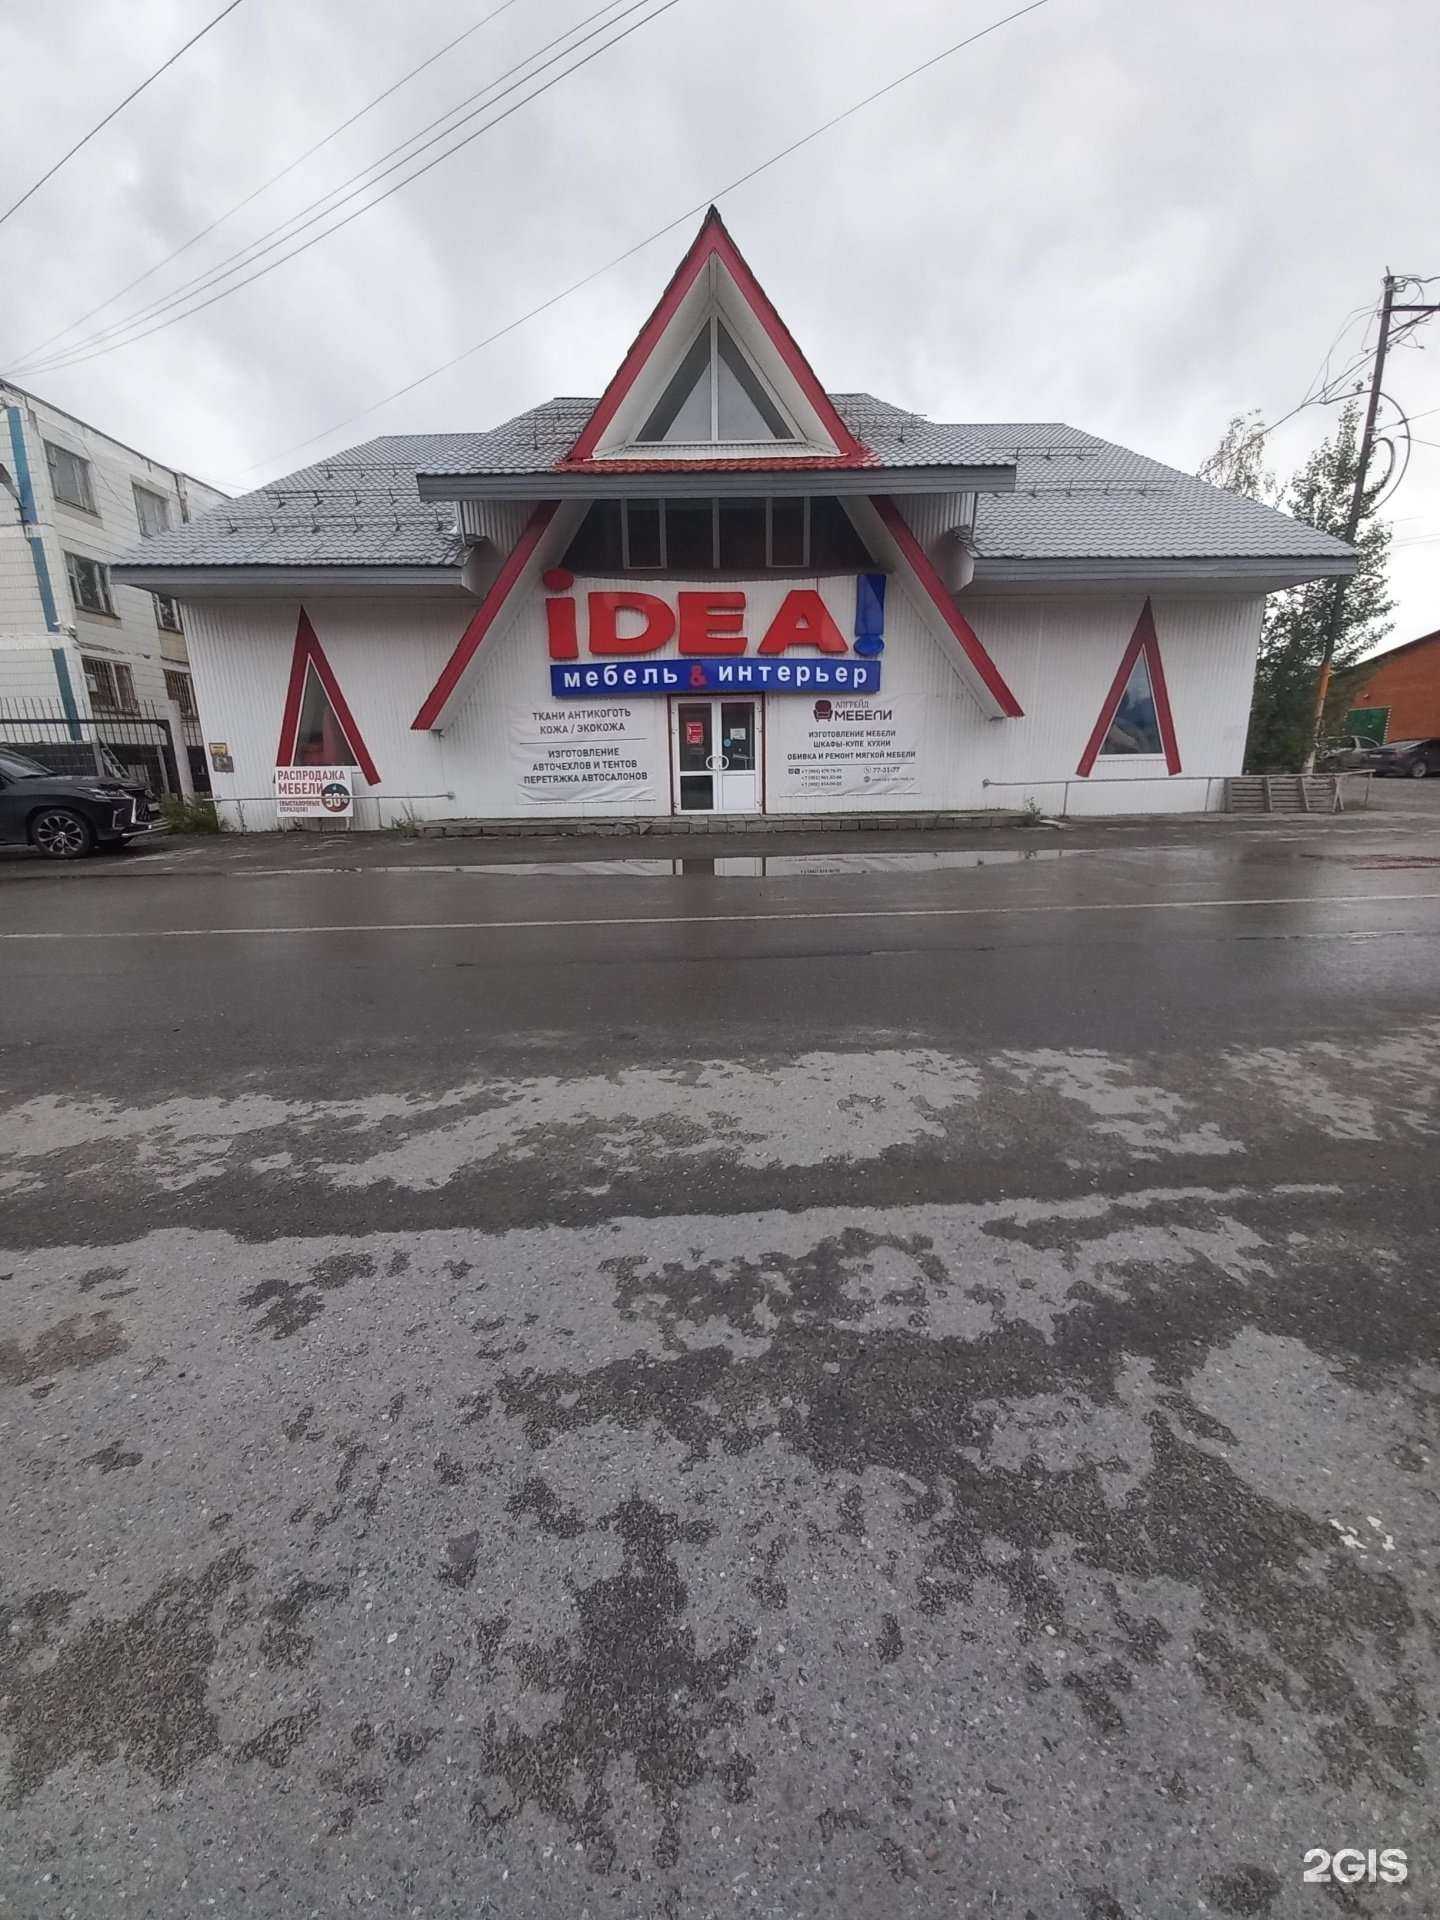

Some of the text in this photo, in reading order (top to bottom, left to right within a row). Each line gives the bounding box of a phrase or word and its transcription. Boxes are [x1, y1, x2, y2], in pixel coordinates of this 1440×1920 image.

[564, 664, 868, 688] мебель & интерьер
[532, 708, 632, 721] ТКАНИ АНТИКОГОТЬ
[834, 710, 893, 721] МЕБЕЛИ
[540, 725, 569, 734] КОЖА
[577, 722, 626, 733] ЭКОКОЖА
[808, 730, 865, 738] ИЗГОТОВЛЕНИЕ
[813, 740, 864, 748] ШКАФЫ-КУПЕ
[548, 747, 620, 758] ИЗГОТОВЛЕНИЕ
[787, 753, 817, 761] ОБИВКА
[825, 752, 854, 760] РЕМОНТ
[855, 750, 885, 759] МЯГКОЙ
[532, 759, 638, 771] АВТОЧЕХЛОВ И ТЕНТОВ
[277, 770, 345, 782] РАСПРОДАЖА
[523, 772, 648, 784] ПЕРЕТЯЖКА АВТОСАЛОНОВ
[278, 782, 323, 795] МЕБЕЛИ
